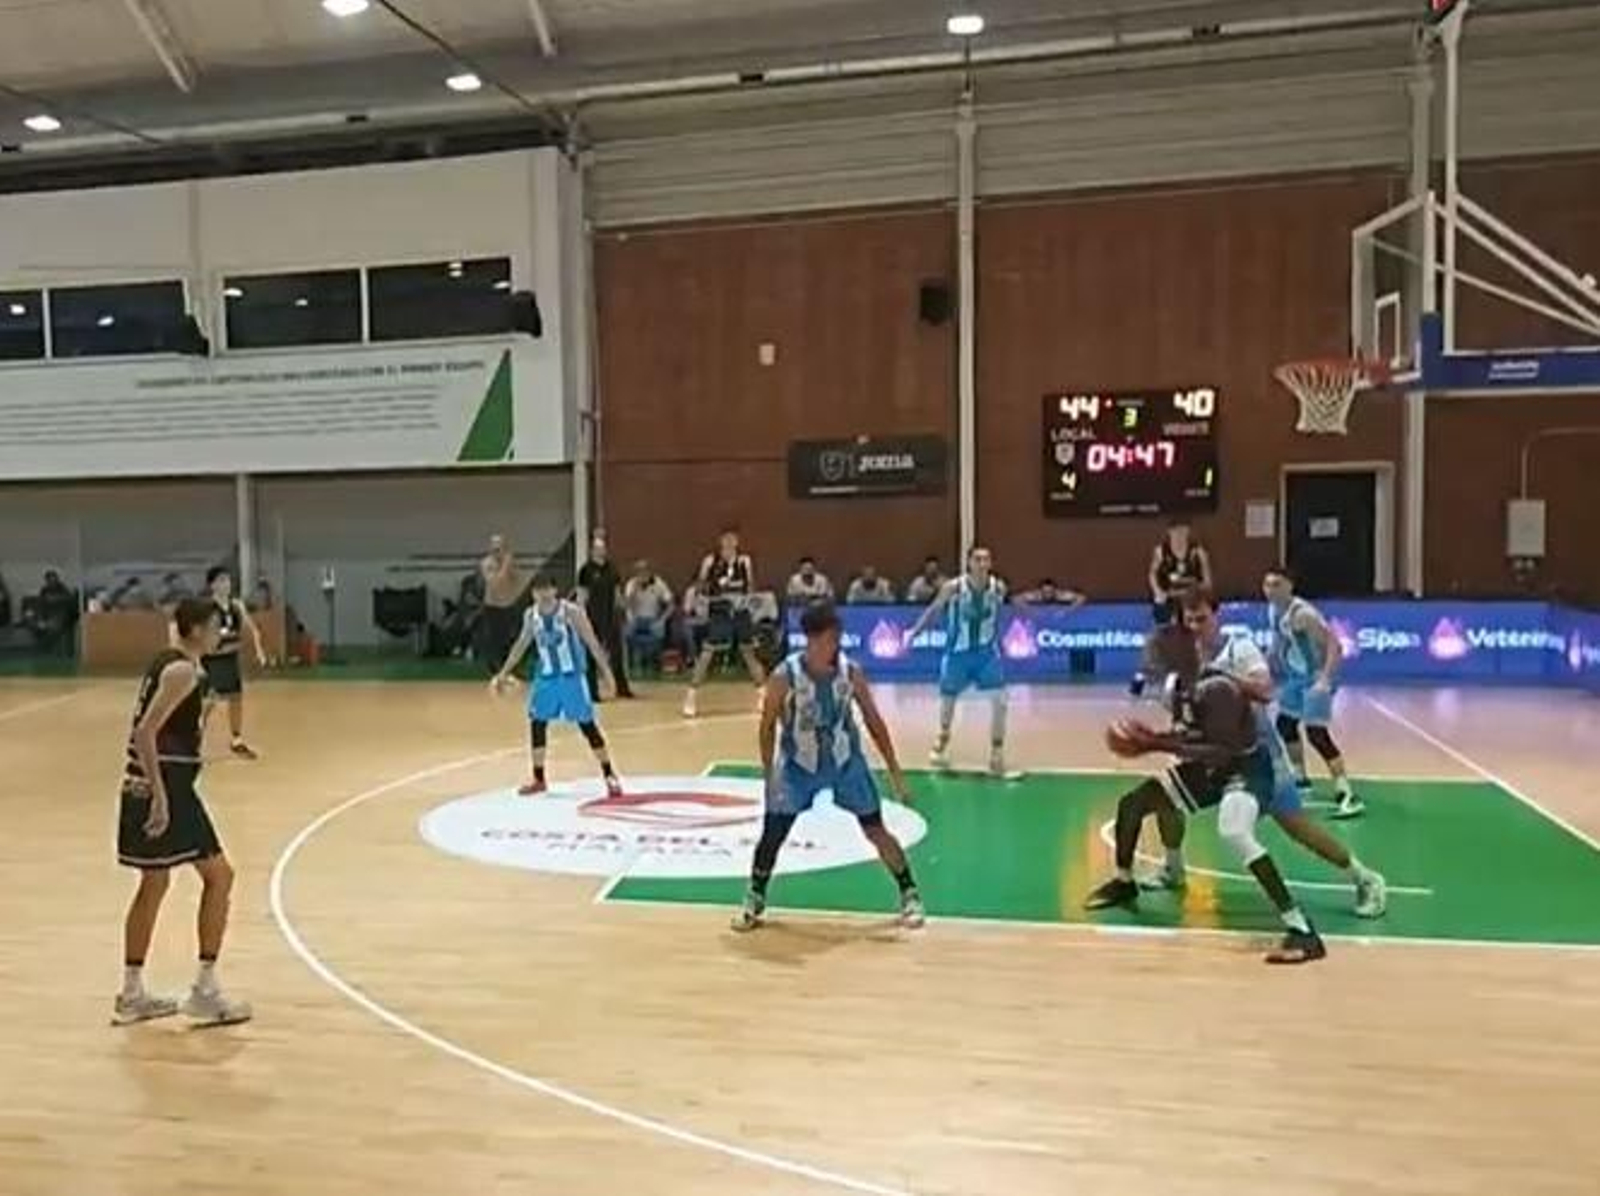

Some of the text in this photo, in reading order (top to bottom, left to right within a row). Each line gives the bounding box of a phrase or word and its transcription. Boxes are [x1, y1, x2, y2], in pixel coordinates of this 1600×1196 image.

[1059, 396, 1100, 421] 44
[1173, 388, 1216, 417] 40
[1123, 407, 1139, 428] 3
[1086, 441, 1176, 472] 04:47
[1060, 471, 1077, 491] 4
[1204, 467, 1214, 487] 1
